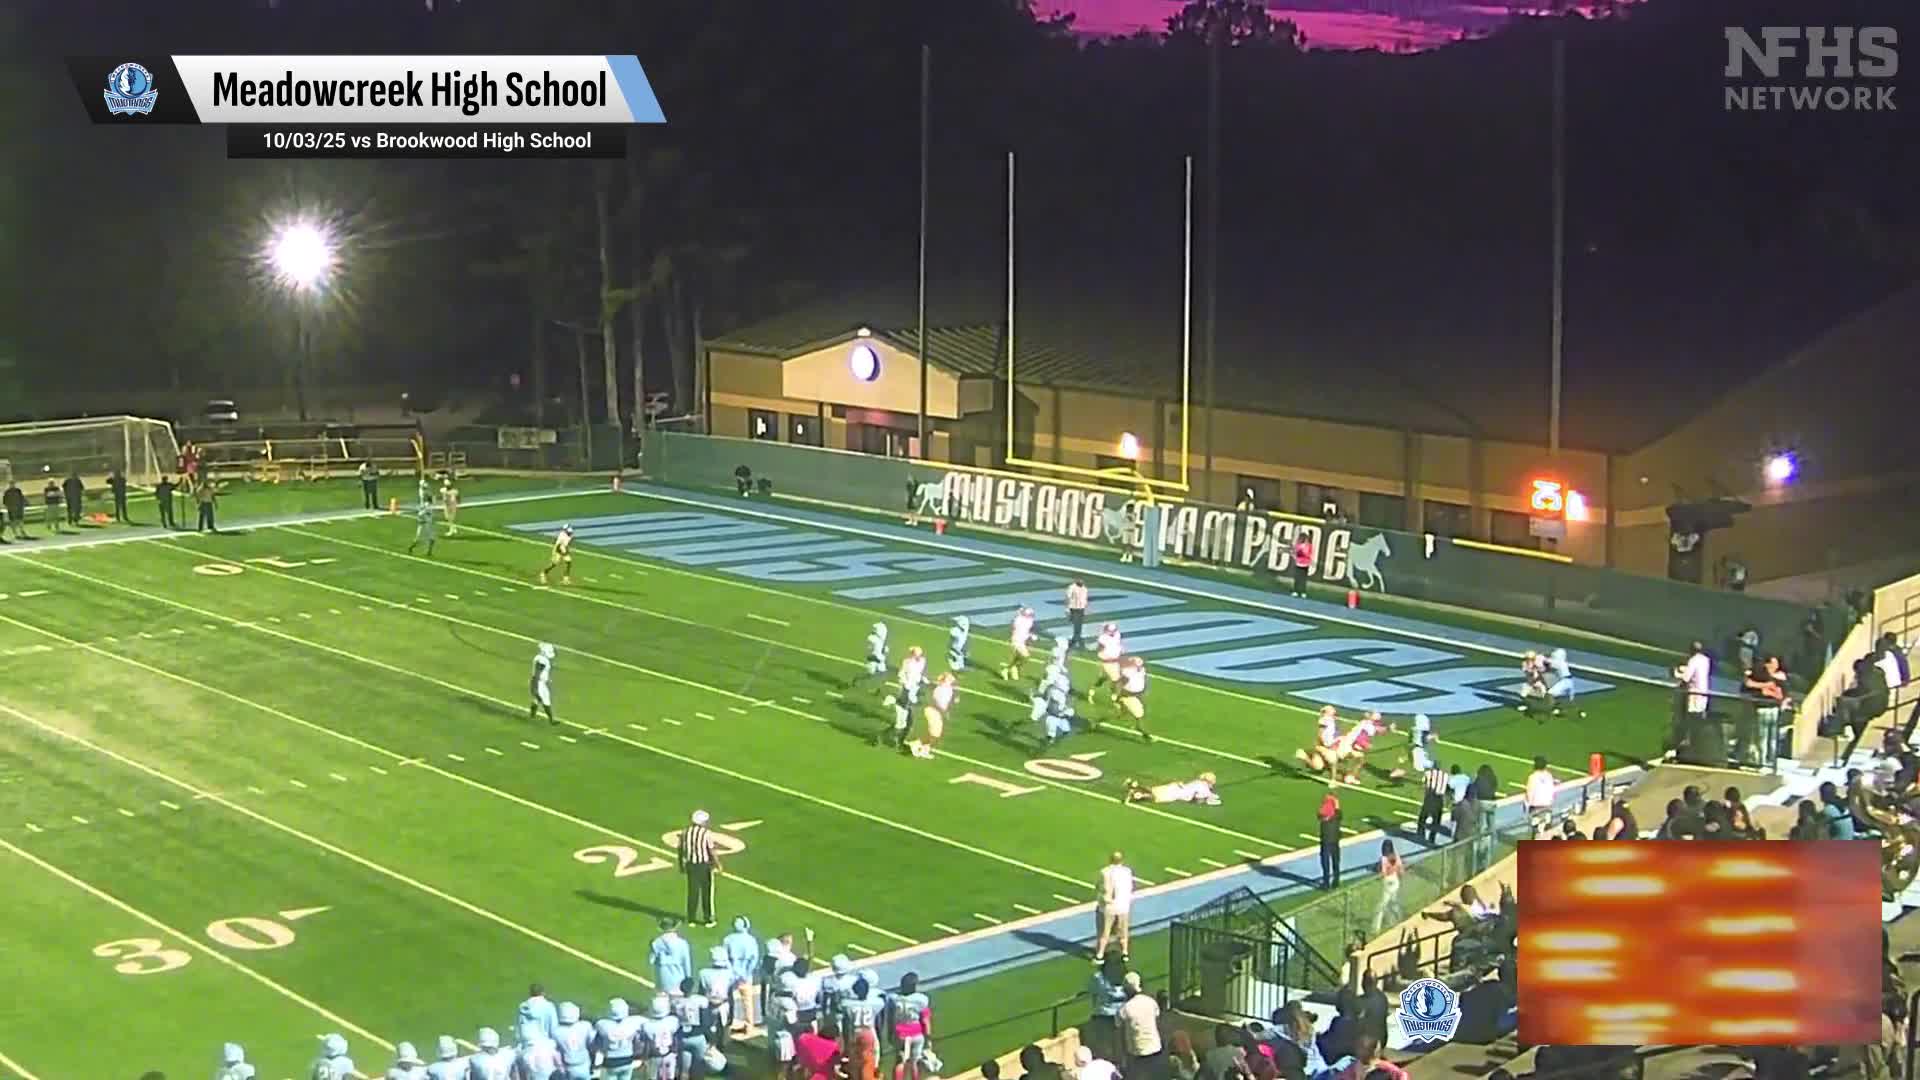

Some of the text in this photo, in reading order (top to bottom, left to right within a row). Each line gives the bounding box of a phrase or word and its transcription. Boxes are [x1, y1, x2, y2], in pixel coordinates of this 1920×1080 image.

[942, 471, 1105, 539] MUSTANG
[948, 758, 1104, 798] 10
[92, 917, 296, 975] 30
